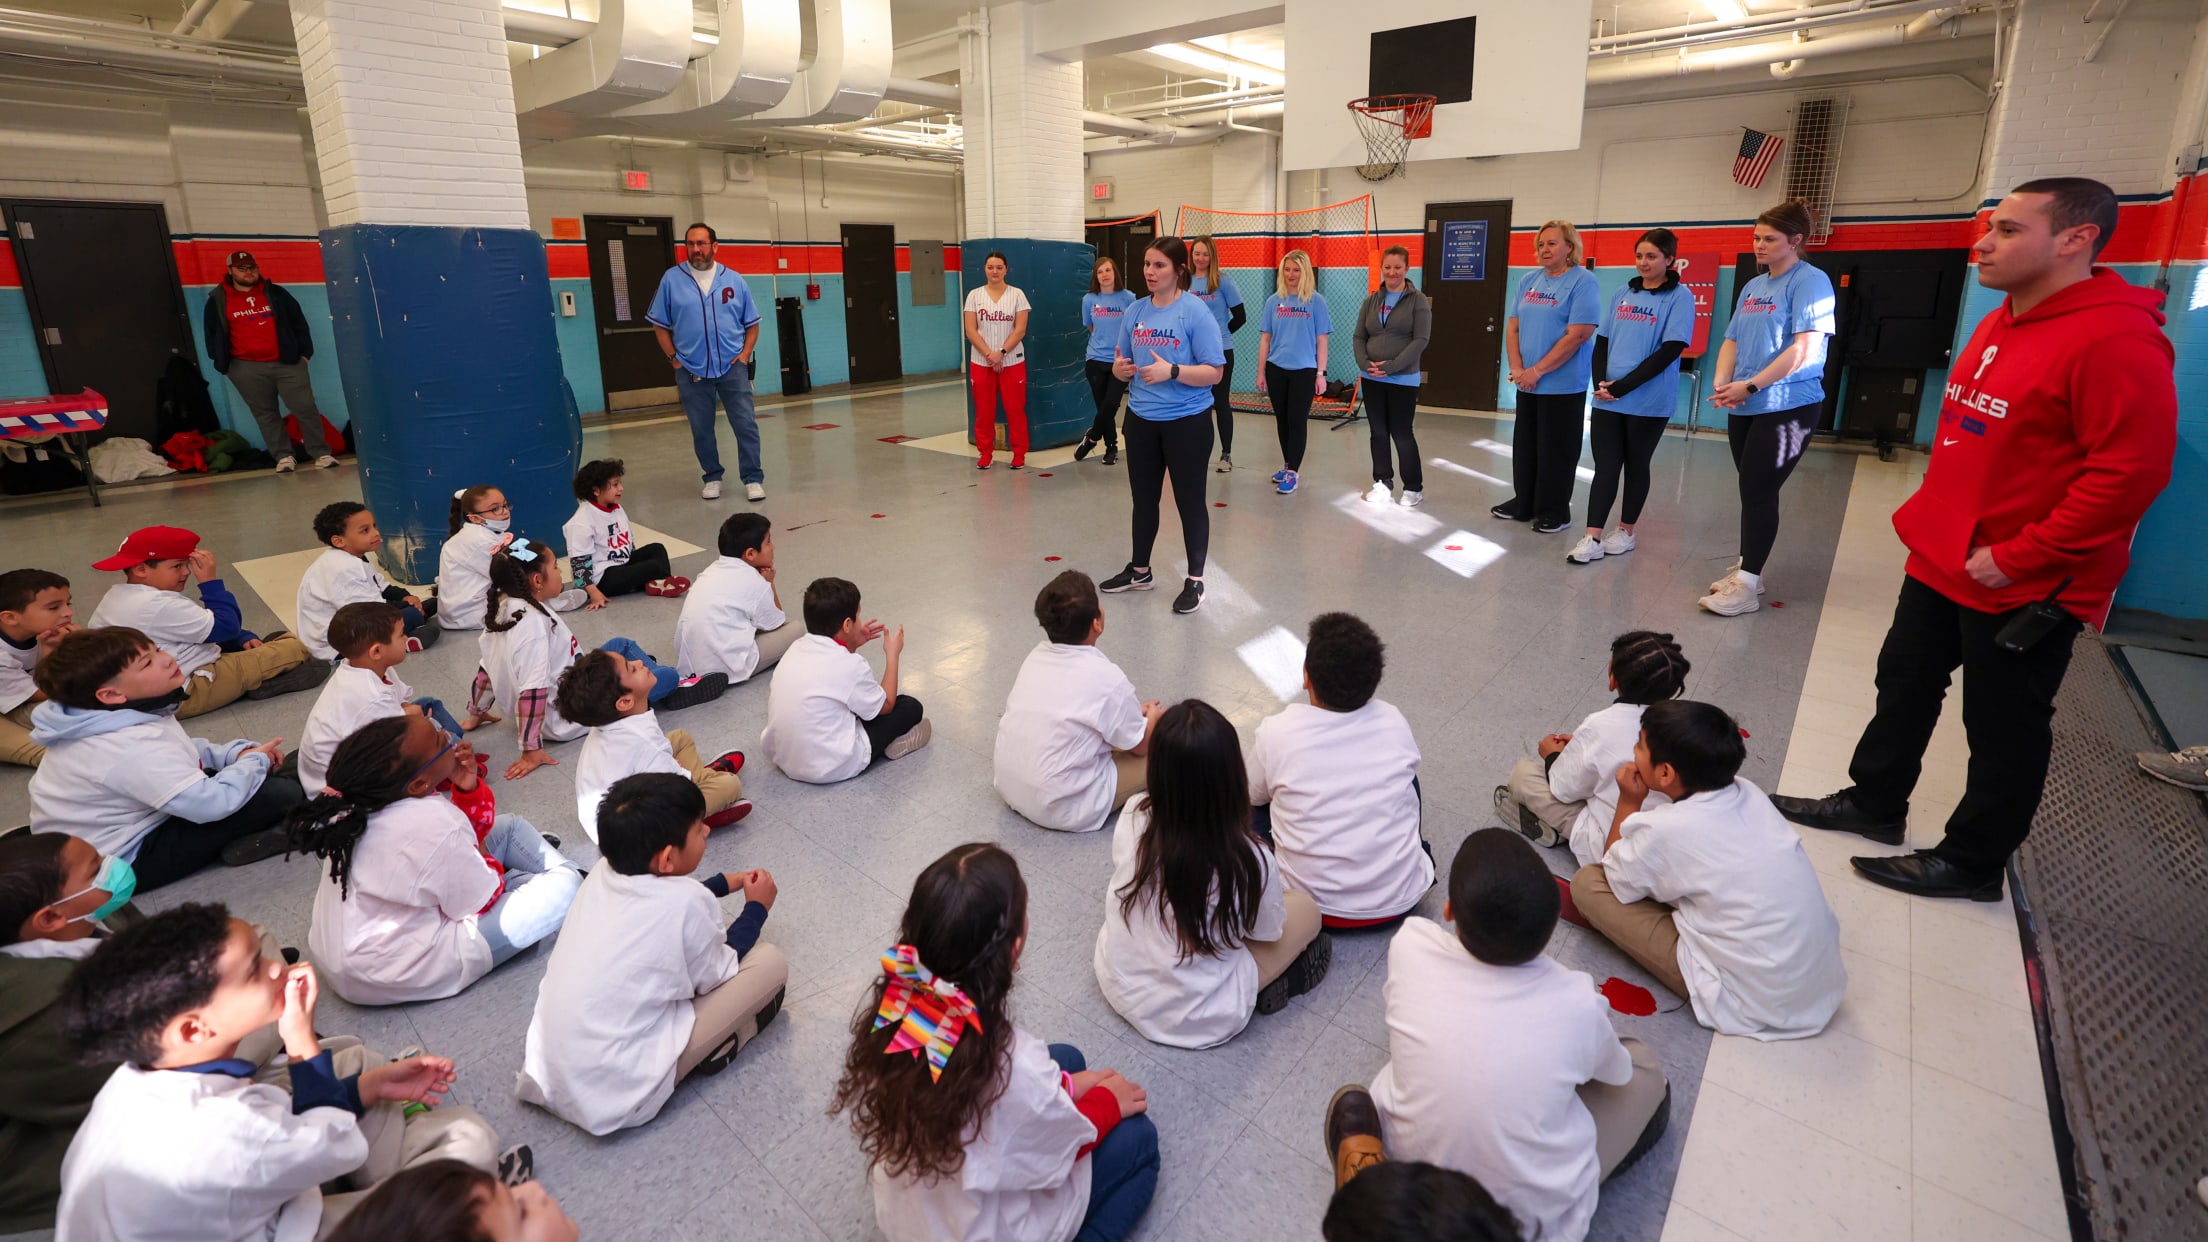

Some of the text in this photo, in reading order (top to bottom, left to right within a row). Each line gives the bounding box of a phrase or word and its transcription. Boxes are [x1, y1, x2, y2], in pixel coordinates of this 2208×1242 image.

[627, 171, 648, 189] EXIT
[1094, 183, 1108, 198] EXIT
[722, 286, 734, 304] P
[233, 305, 272, 318] PHILLIE
[978, 308, 1014, 322] Phillies
[1974, 345, 1998, 380] P
[1945, 382, 2009, 418] HILLIES
